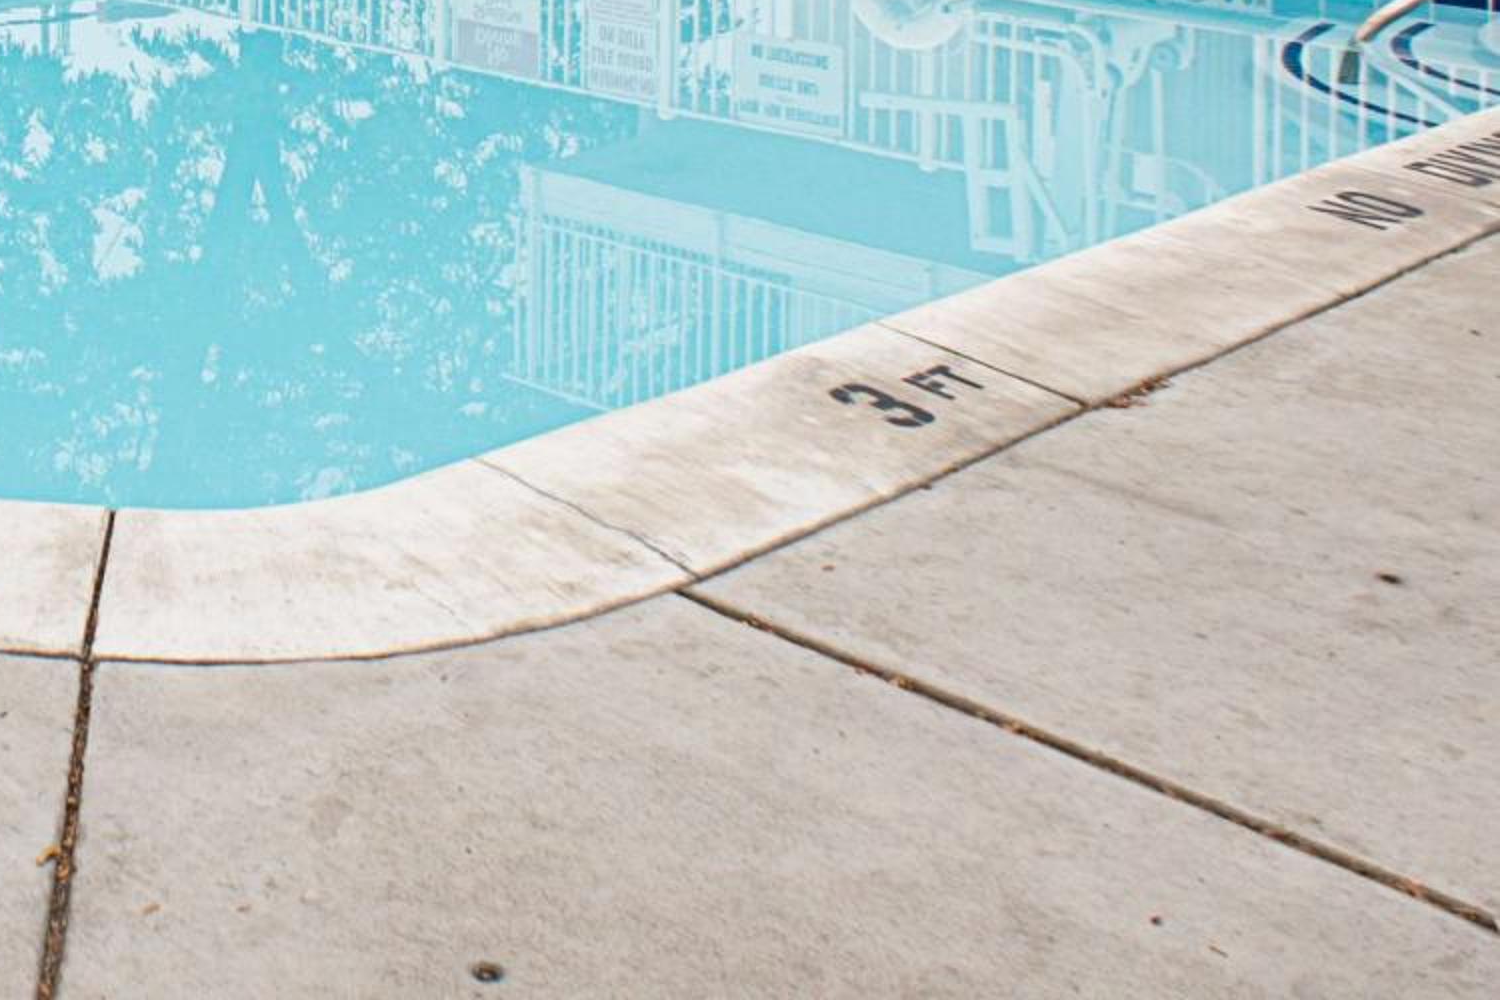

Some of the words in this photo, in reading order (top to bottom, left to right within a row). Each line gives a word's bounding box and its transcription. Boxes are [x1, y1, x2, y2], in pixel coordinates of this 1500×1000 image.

[1305, 191, 1425, 231] NO
[828, 382, 935, 428] 3
[900, 364, 985, 400] FT
